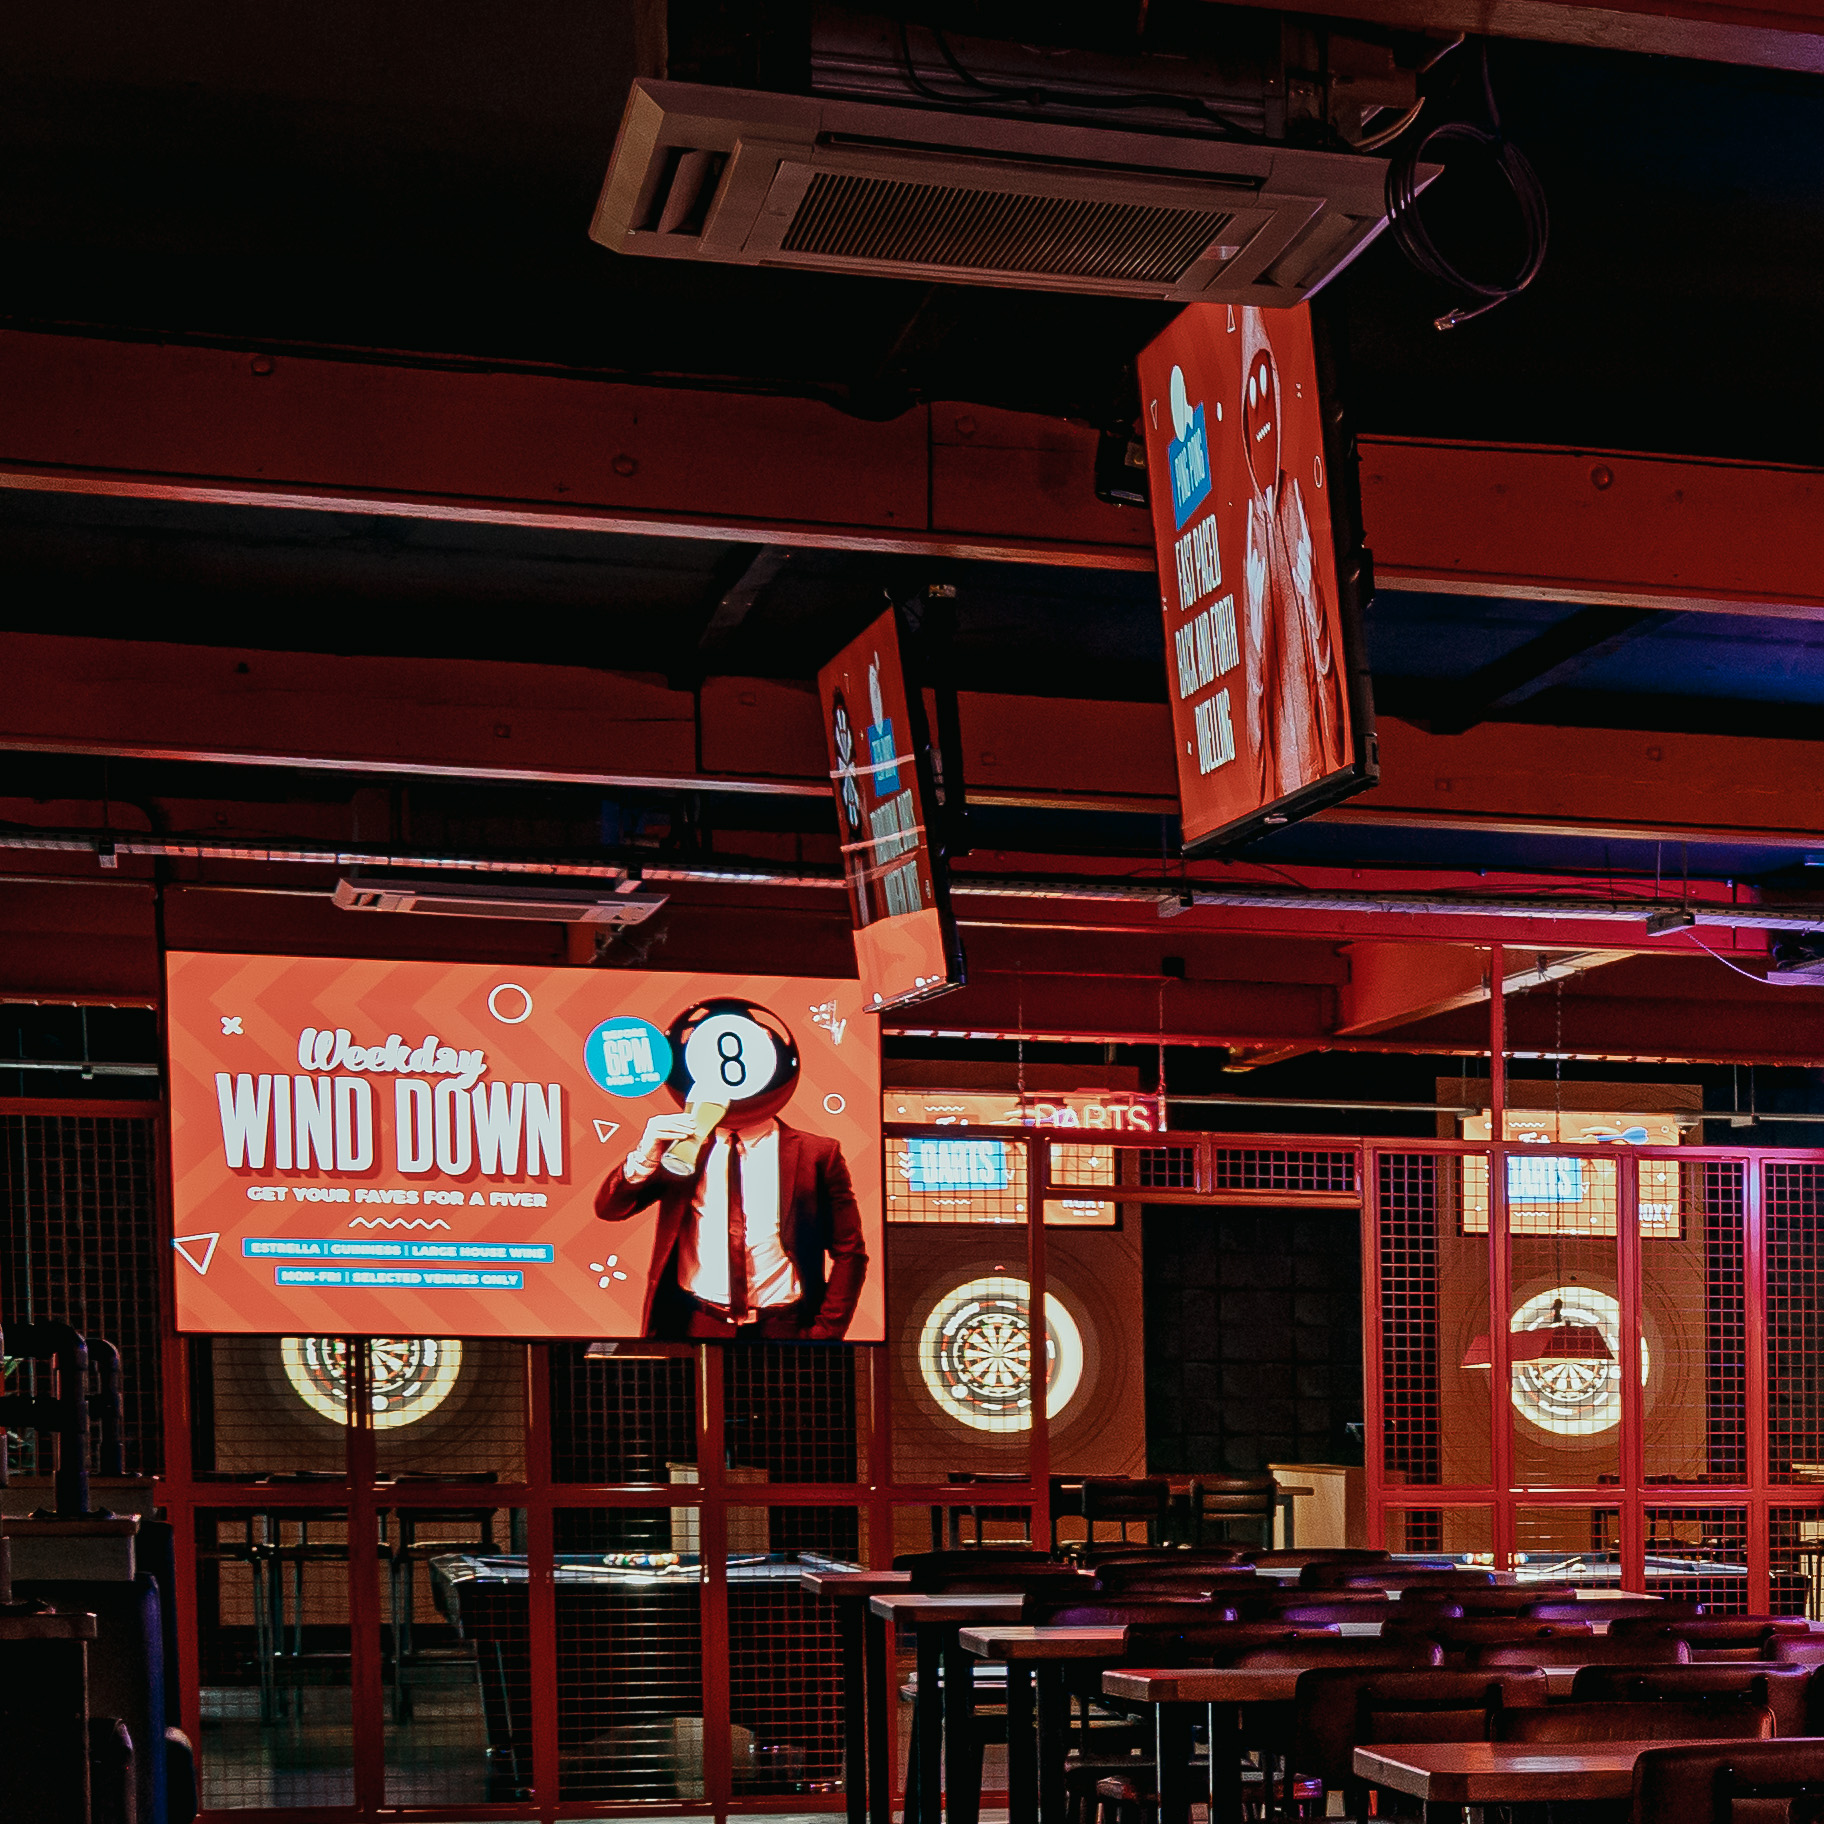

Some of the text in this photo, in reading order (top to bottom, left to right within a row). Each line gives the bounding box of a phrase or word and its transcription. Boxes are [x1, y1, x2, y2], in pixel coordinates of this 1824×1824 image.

[298, 1027, 488, 1089] Weekday
[603, 1037, 654, 1076] 6PM
[717, 1031, 747, 1086] 8
[215, 1073, 563, 1176] WIND DOWN
[920, 1141, 995, 1184] DARTS
[247, 1186, 548, 1208] GET YOUR FAVES FOR A FIVER
